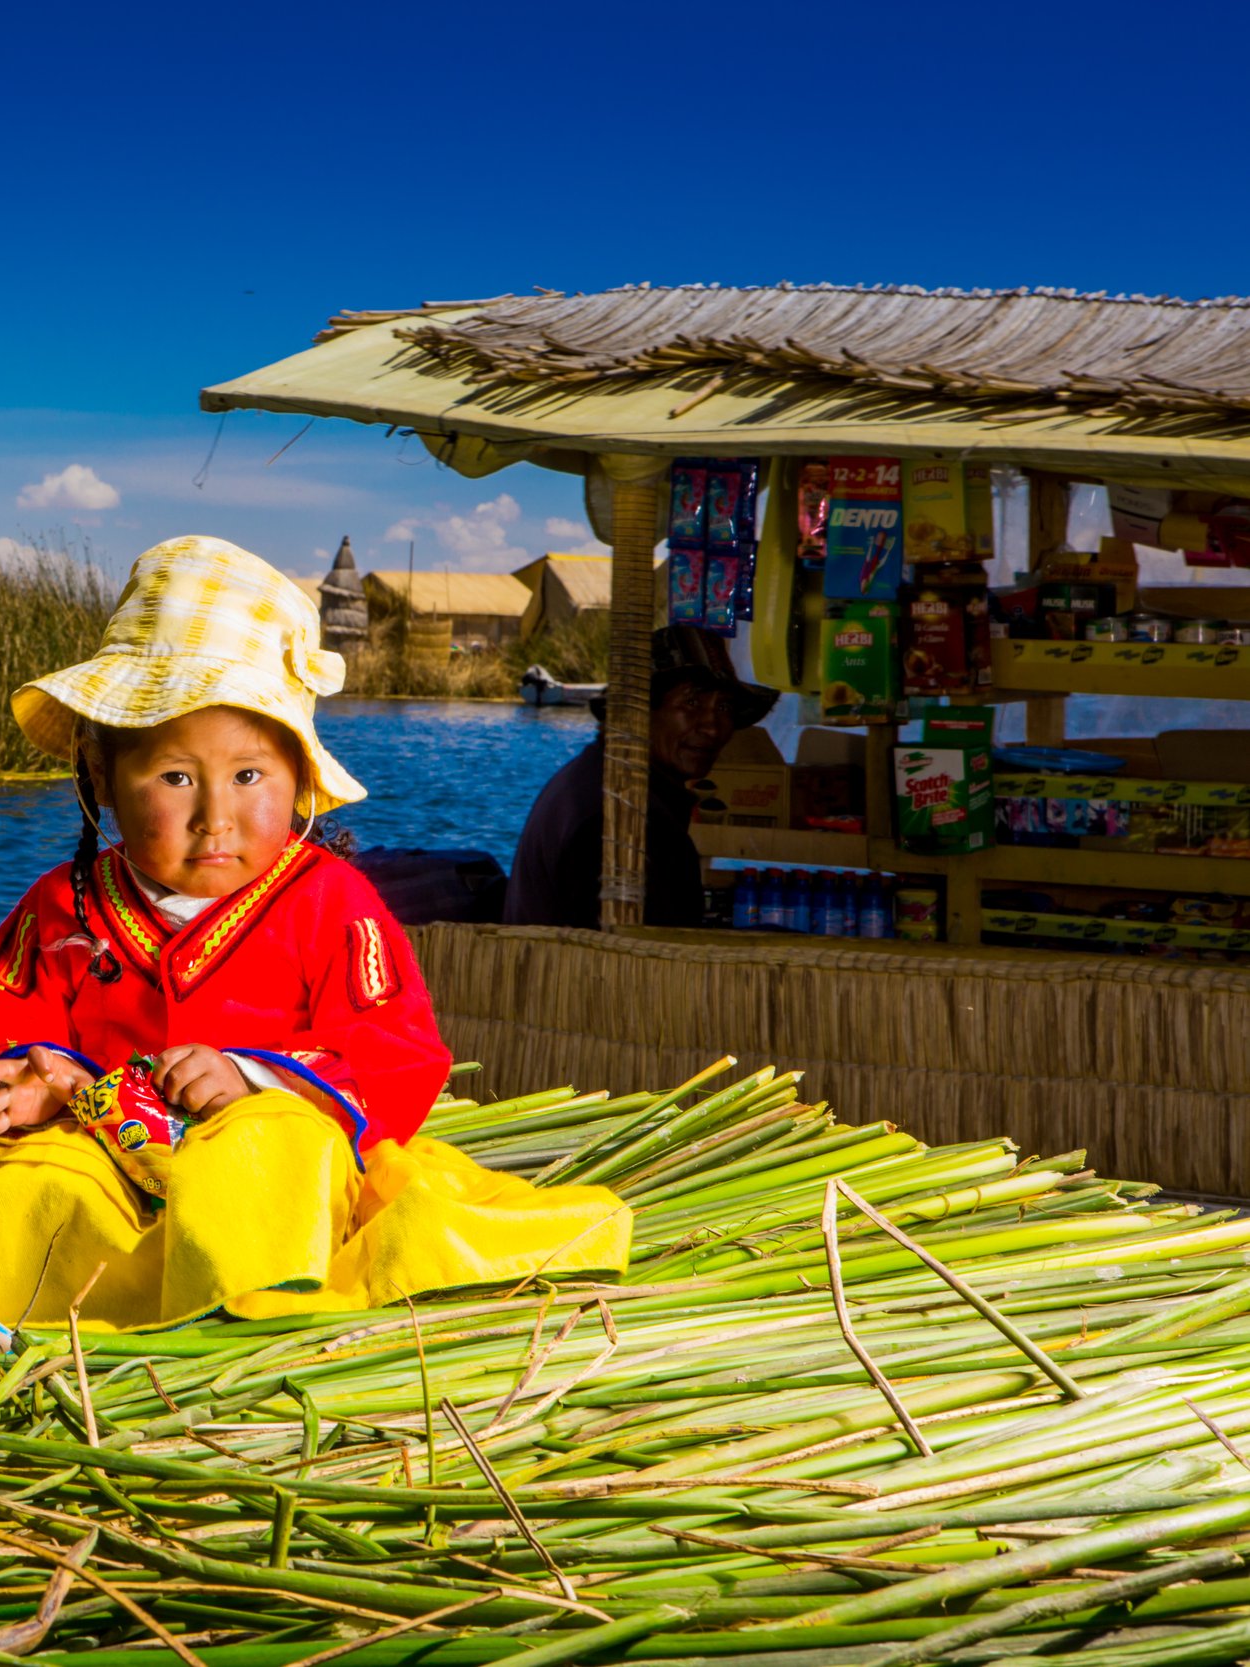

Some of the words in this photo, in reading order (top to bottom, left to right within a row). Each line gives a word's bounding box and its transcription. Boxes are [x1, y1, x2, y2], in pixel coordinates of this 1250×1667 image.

[912, 467, 948, 483] HERBI
[829, 508, 898, 531] DENTO
[911, 602, 949, 617] HERBI
[1070, 598, 1096, 610] MUSK
[834, 632, 874, 648] HERBI
[905, 774, 949, 795] Scotch
[914, 789, 948, 809] Brite
